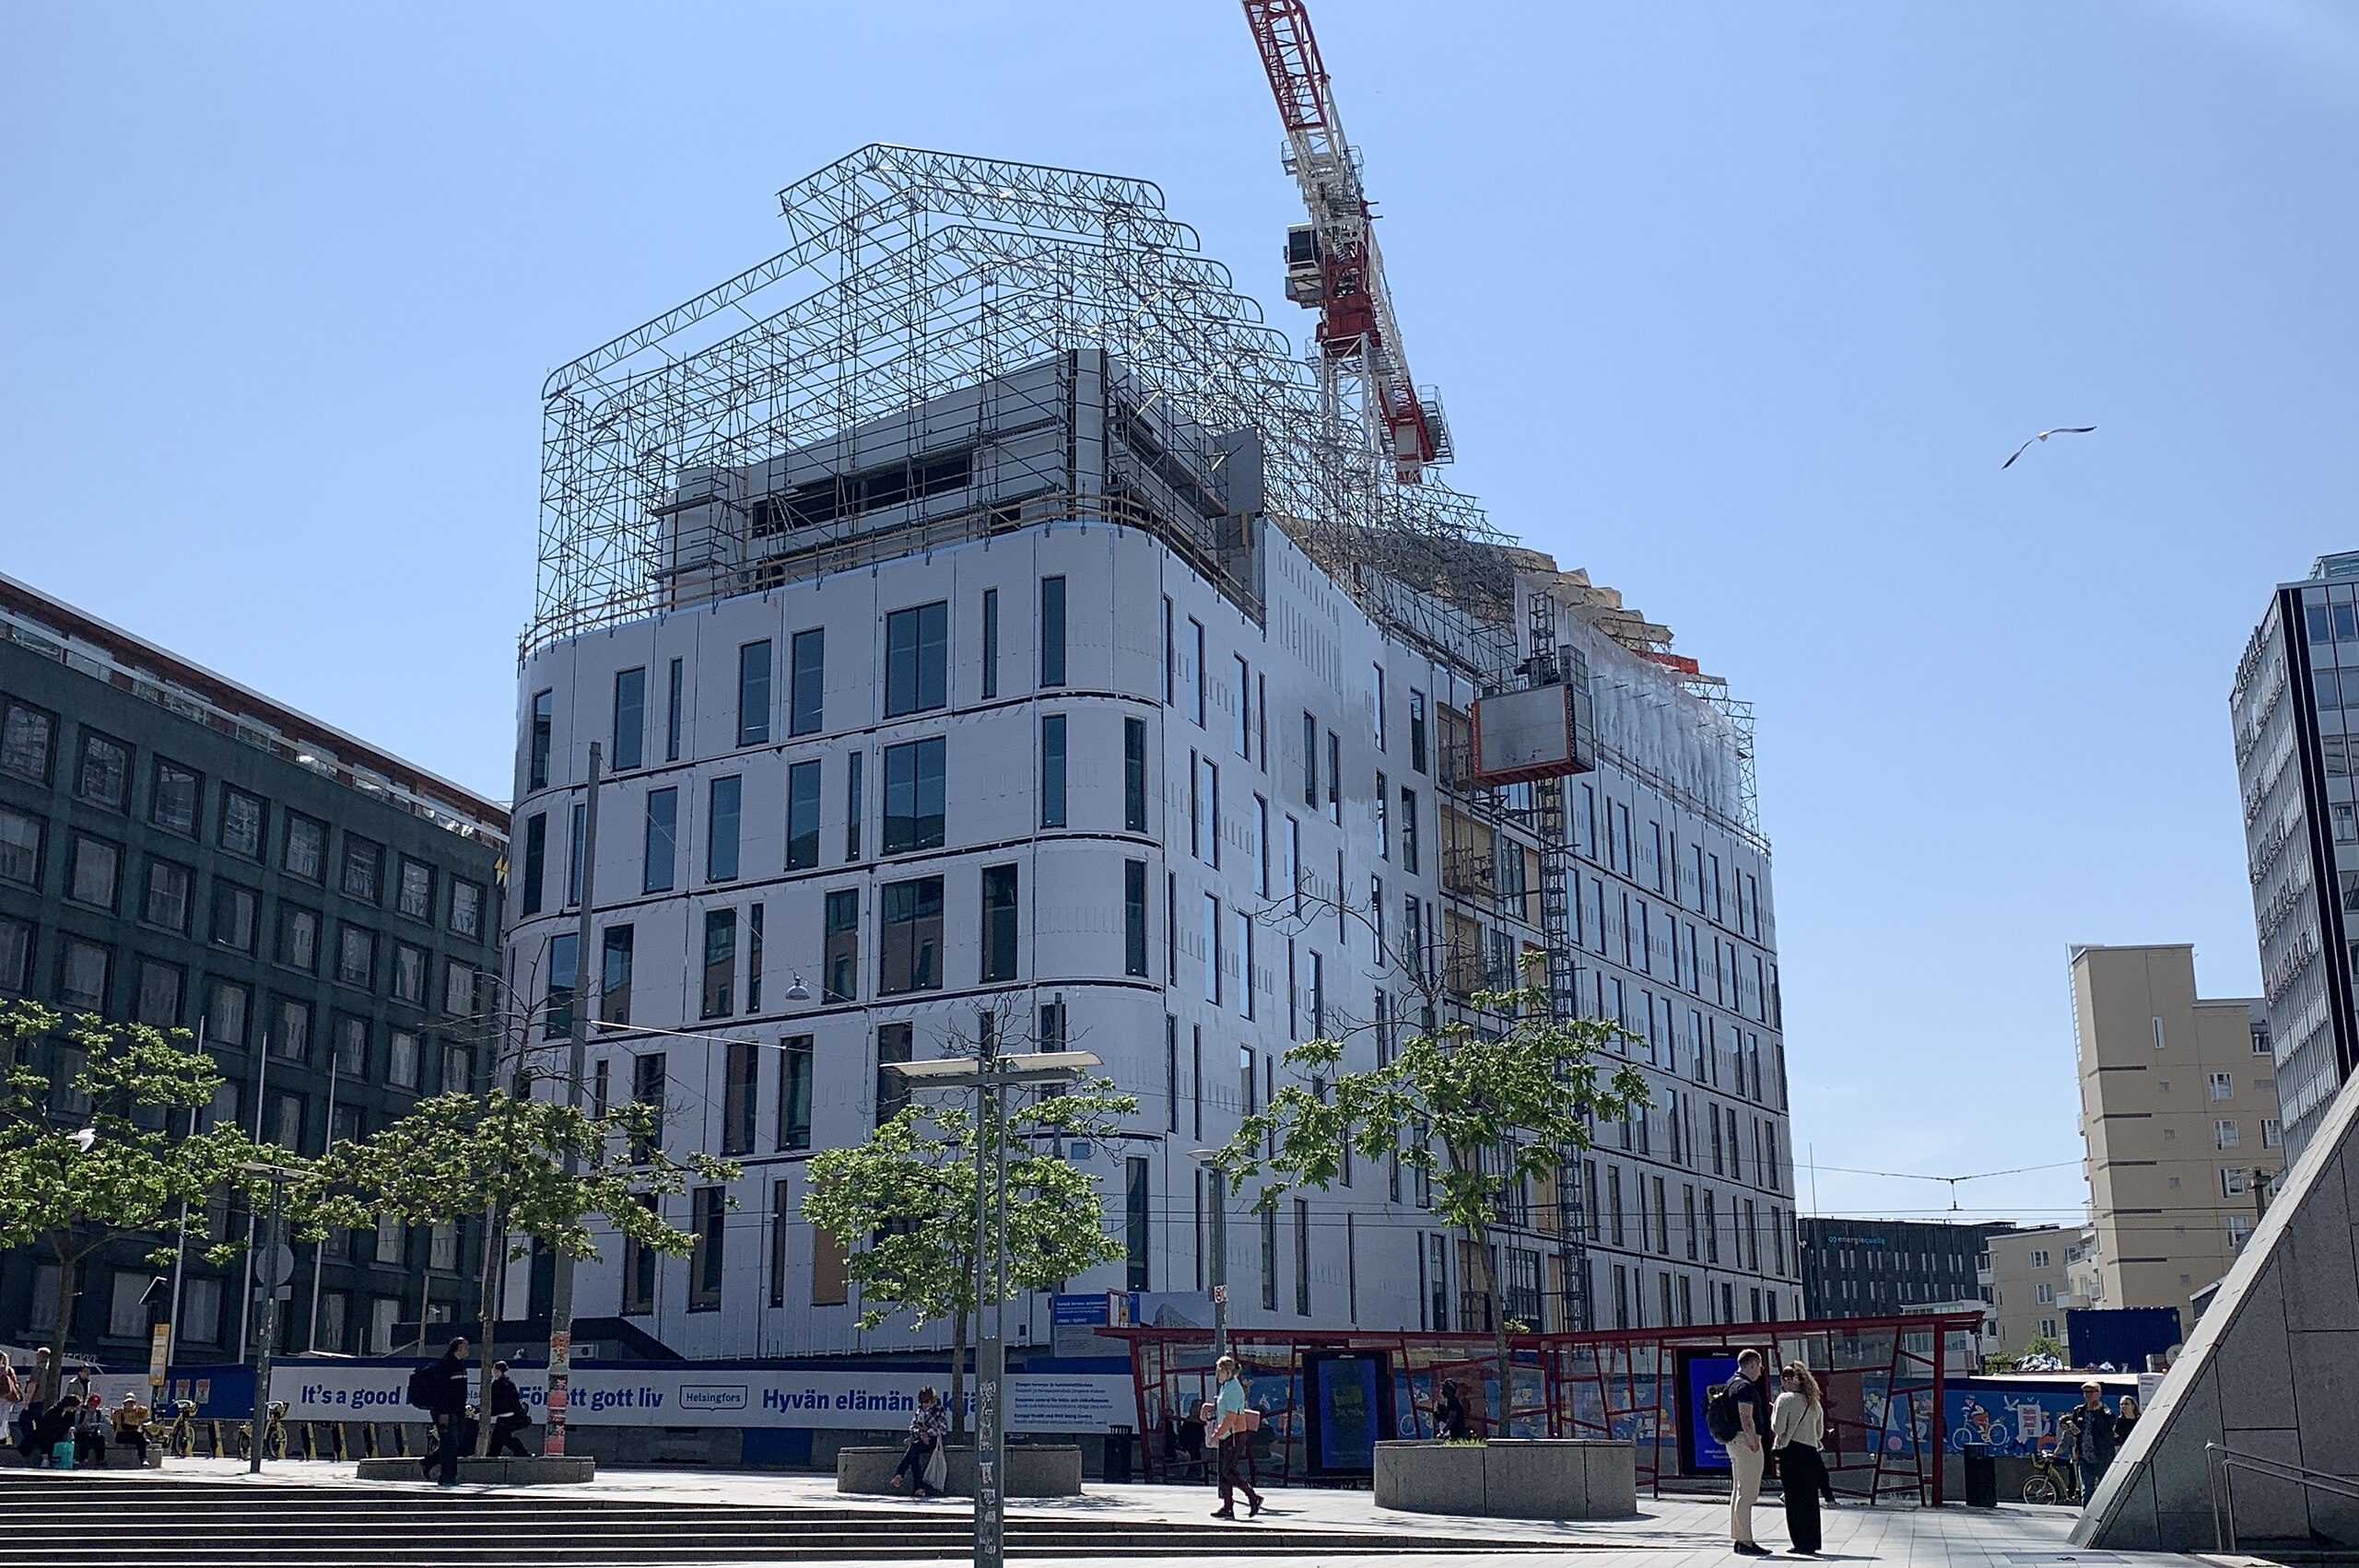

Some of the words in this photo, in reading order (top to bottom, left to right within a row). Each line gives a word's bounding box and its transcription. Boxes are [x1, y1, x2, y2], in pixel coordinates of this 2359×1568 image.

[335, 1390, 346, 1405] a
[350, 1386, 402, 1410] good
[591, 1389, 633, 1411] gott
[638, 1387, 663, 1408] liv
[686, 1392, 742, 1405] Helsingfors
[762, 1388, 829, 1414] Hyvän
[835, 1389, 914, 1411] elämän
